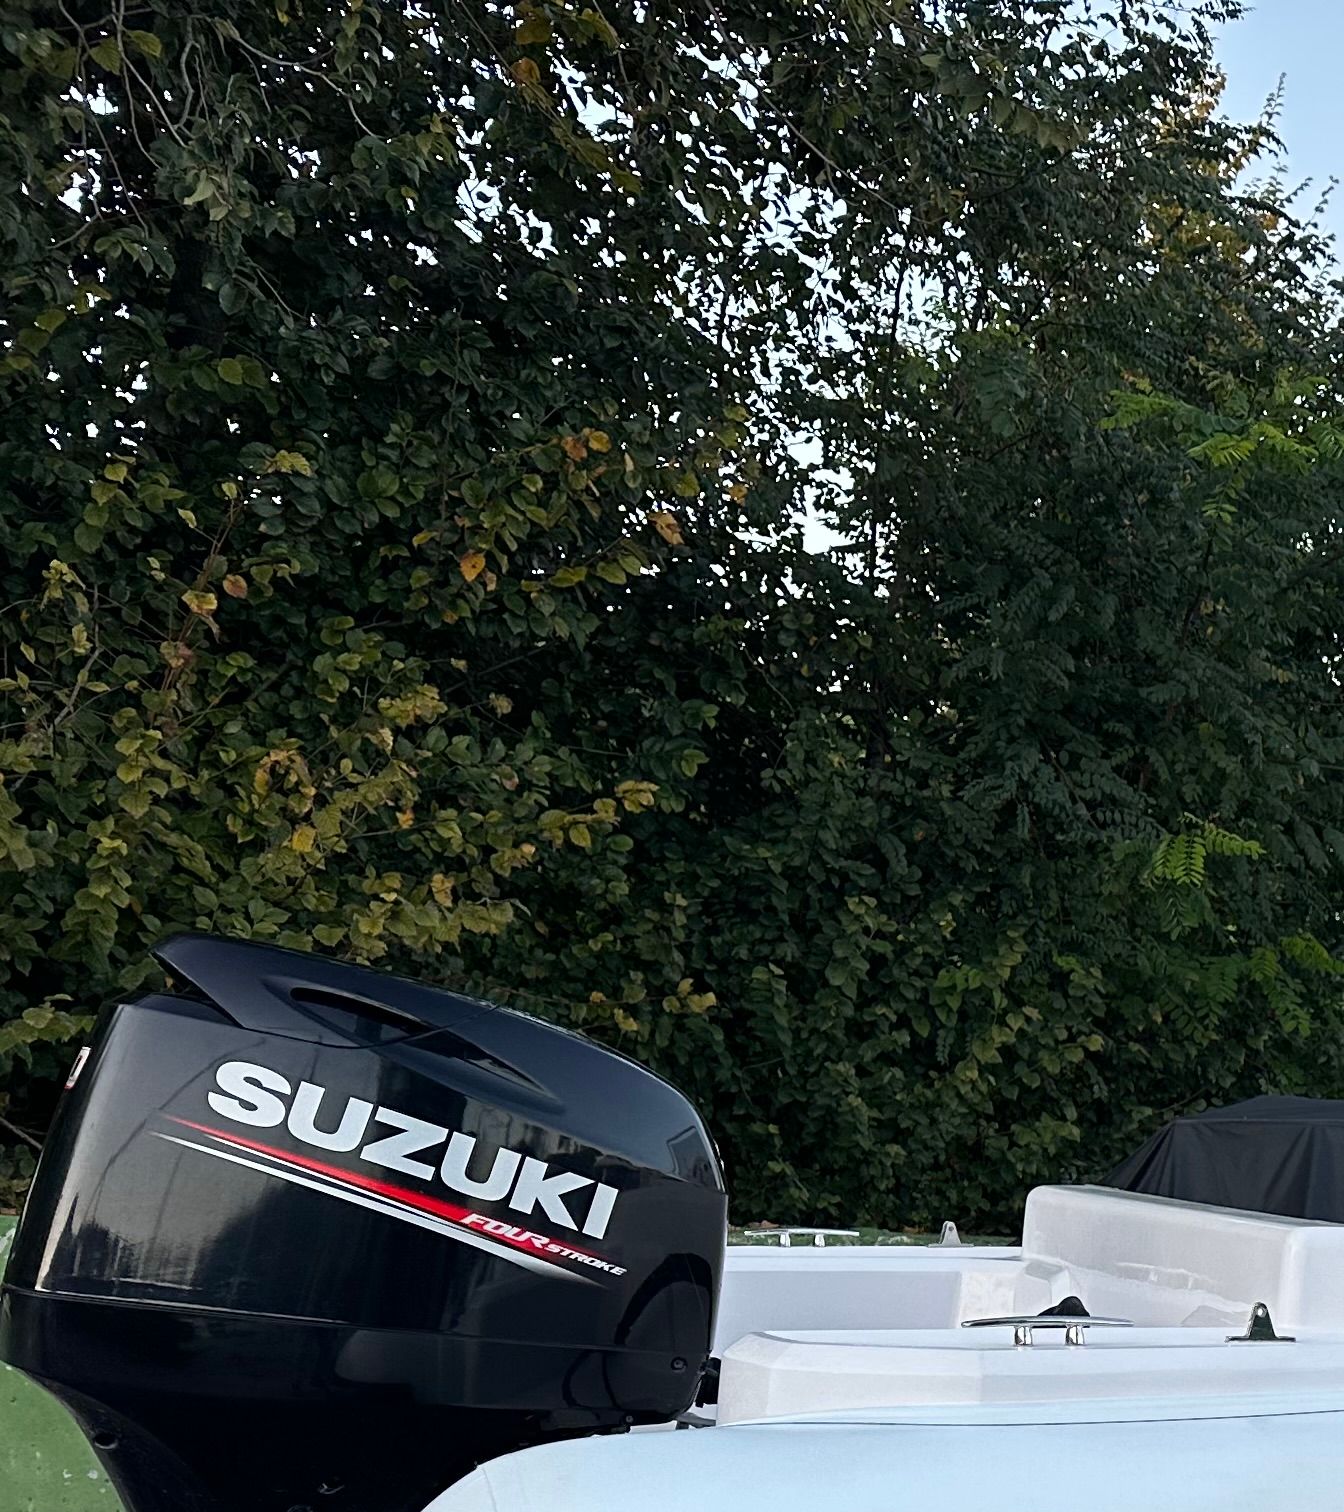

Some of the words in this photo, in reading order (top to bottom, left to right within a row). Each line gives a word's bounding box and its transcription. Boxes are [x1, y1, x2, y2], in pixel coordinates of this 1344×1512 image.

[207, 1060, 619, 1240] SUZUKI
[460, 1213, 550, 1249] FOUR
[547, 1243, 628, 1276] STROKE
